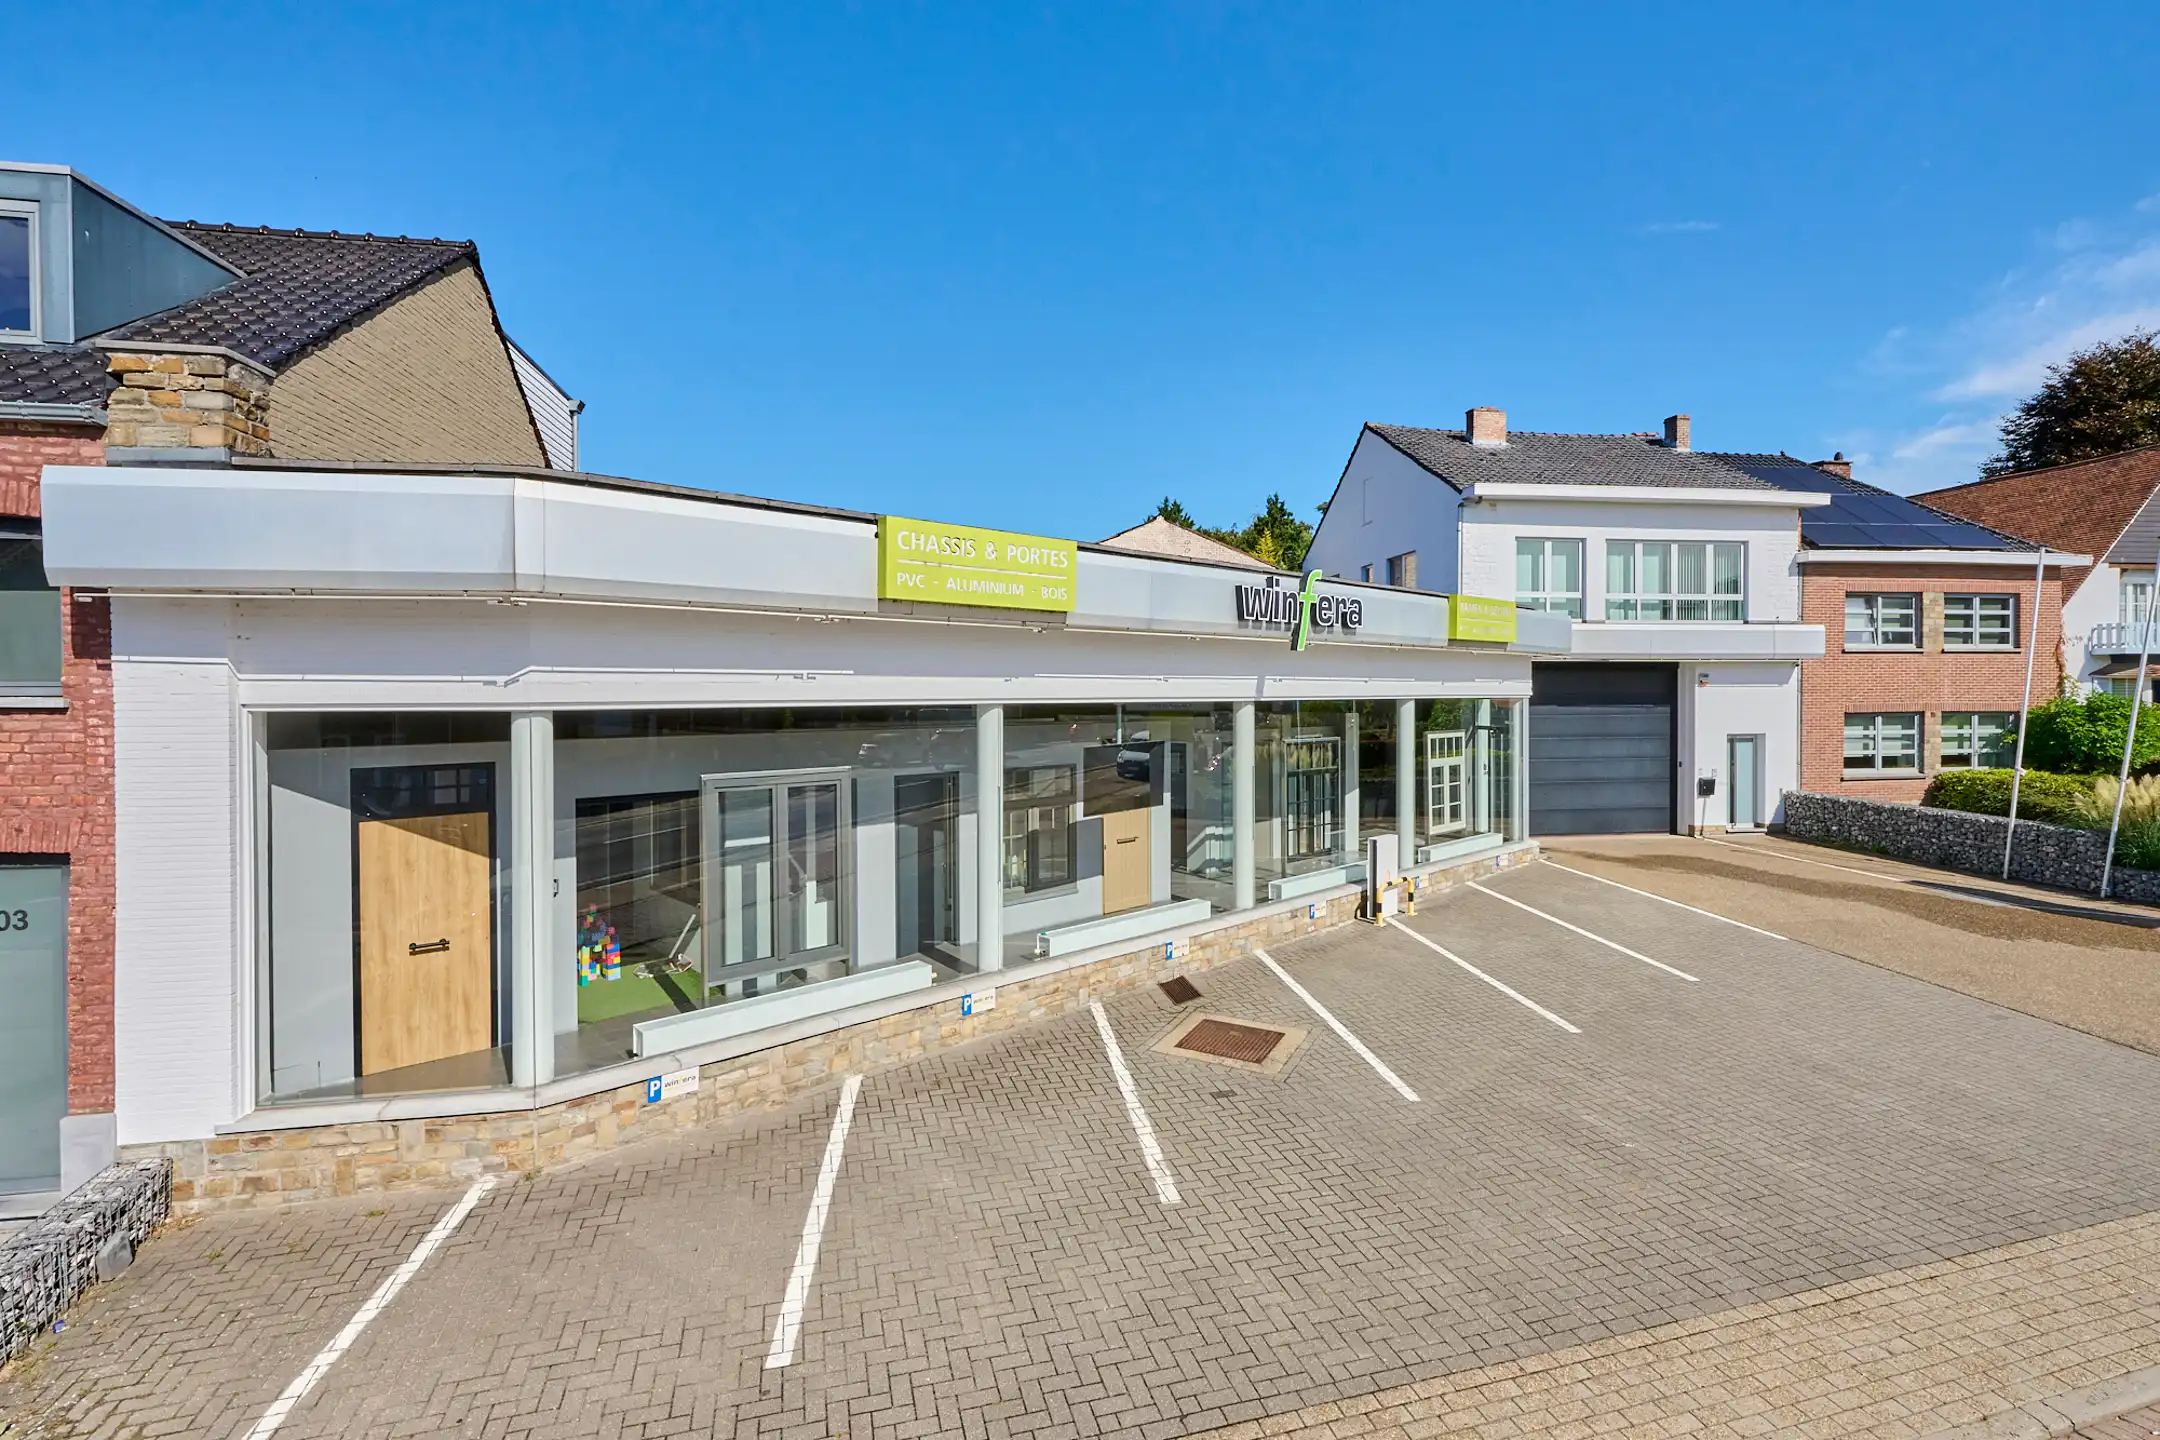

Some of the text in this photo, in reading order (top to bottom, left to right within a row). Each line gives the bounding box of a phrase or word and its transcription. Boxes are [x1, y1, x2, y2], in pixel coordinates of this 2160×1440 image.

[897, 530, 1068, 568] CHASSIS & PORTES
[897, 572, 925, 588] PVC
[946, 577, 1024, 596] ALUMINIUM
[1041, 586, 1068, 600] BOIS
[1240, 569, 1363, 651] winfera
[650, 1080, 660, 1097] P
